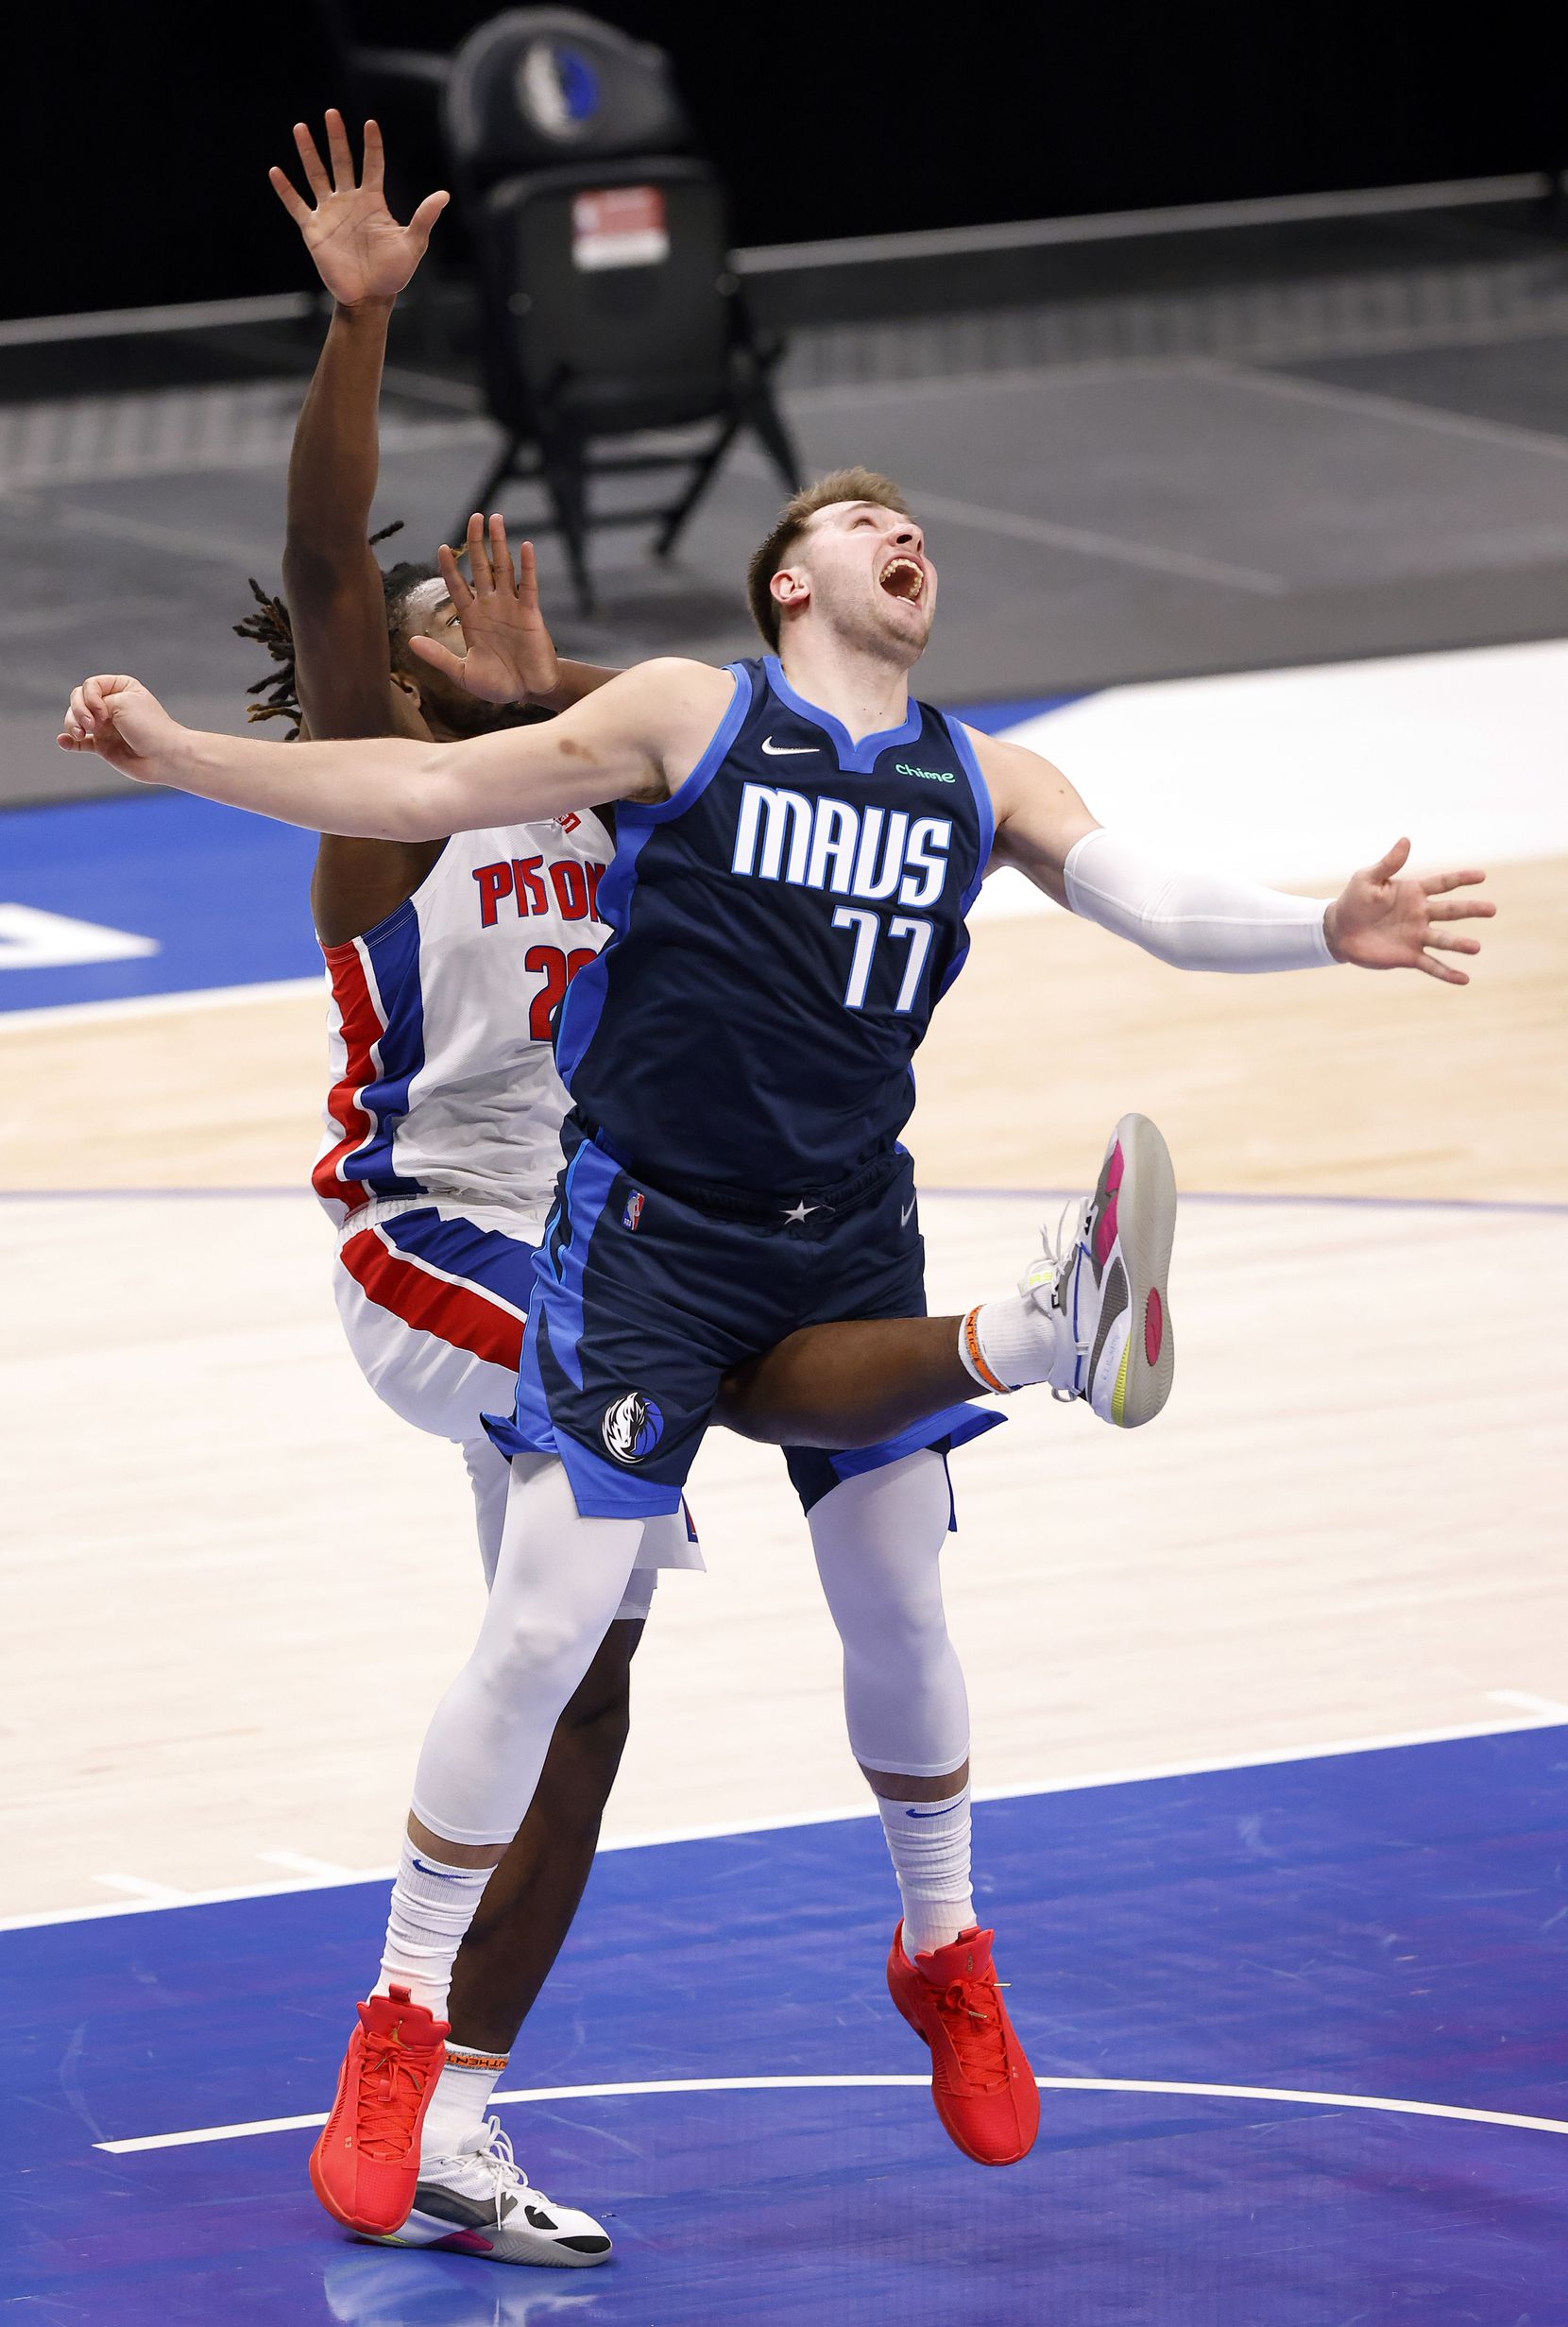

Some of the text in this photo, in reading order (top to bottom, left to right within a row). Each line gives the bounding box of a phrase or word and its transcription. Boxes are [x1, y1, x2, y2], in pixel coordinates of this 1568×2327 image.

[895, 763, 956, 783] chime
[731, 781, 953, 909] MAVS
[831, 904, 934, 1013] 77
[446, 2054, 507, 2068] UTHENT
